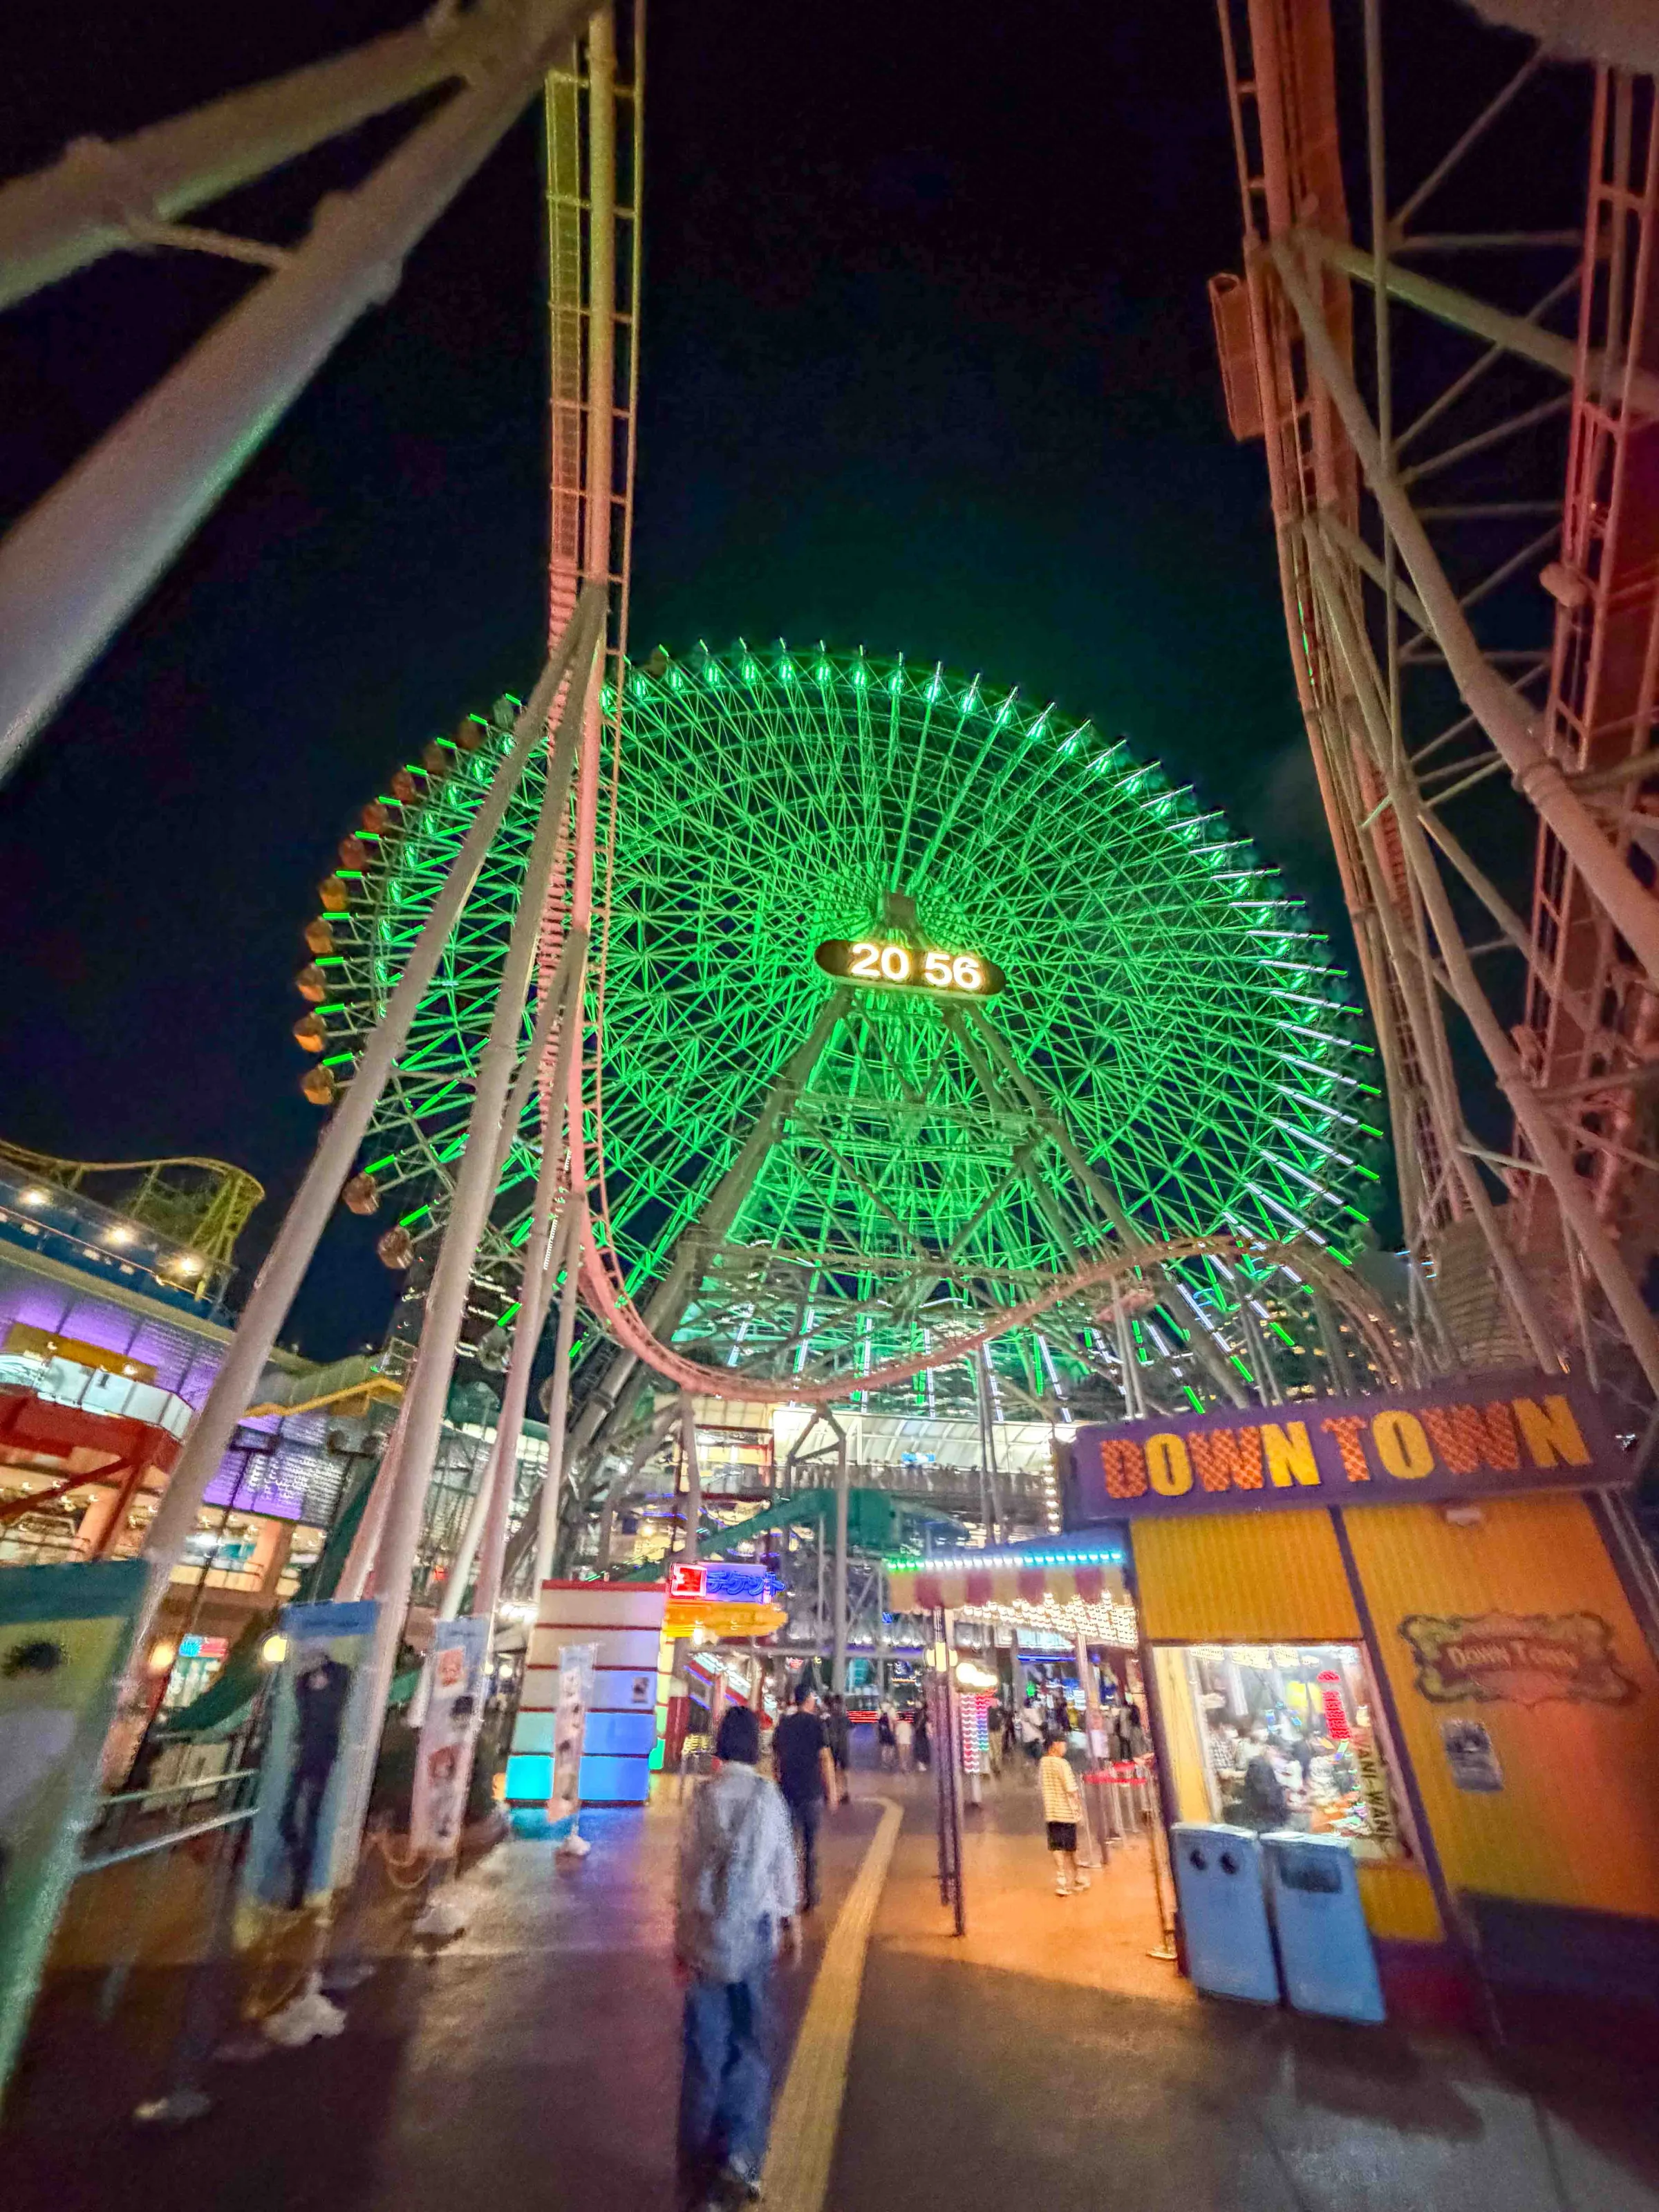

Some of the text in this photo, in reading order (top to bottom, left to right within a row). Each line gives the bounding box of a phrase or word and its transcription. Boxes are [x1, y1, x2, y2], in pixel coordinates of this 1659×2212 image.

[850, 943, 982, 990] 20 56
[1100, 1394, 1592, 1499] DOWN TOWN
[706, 1571, 786, 1596] チケット
